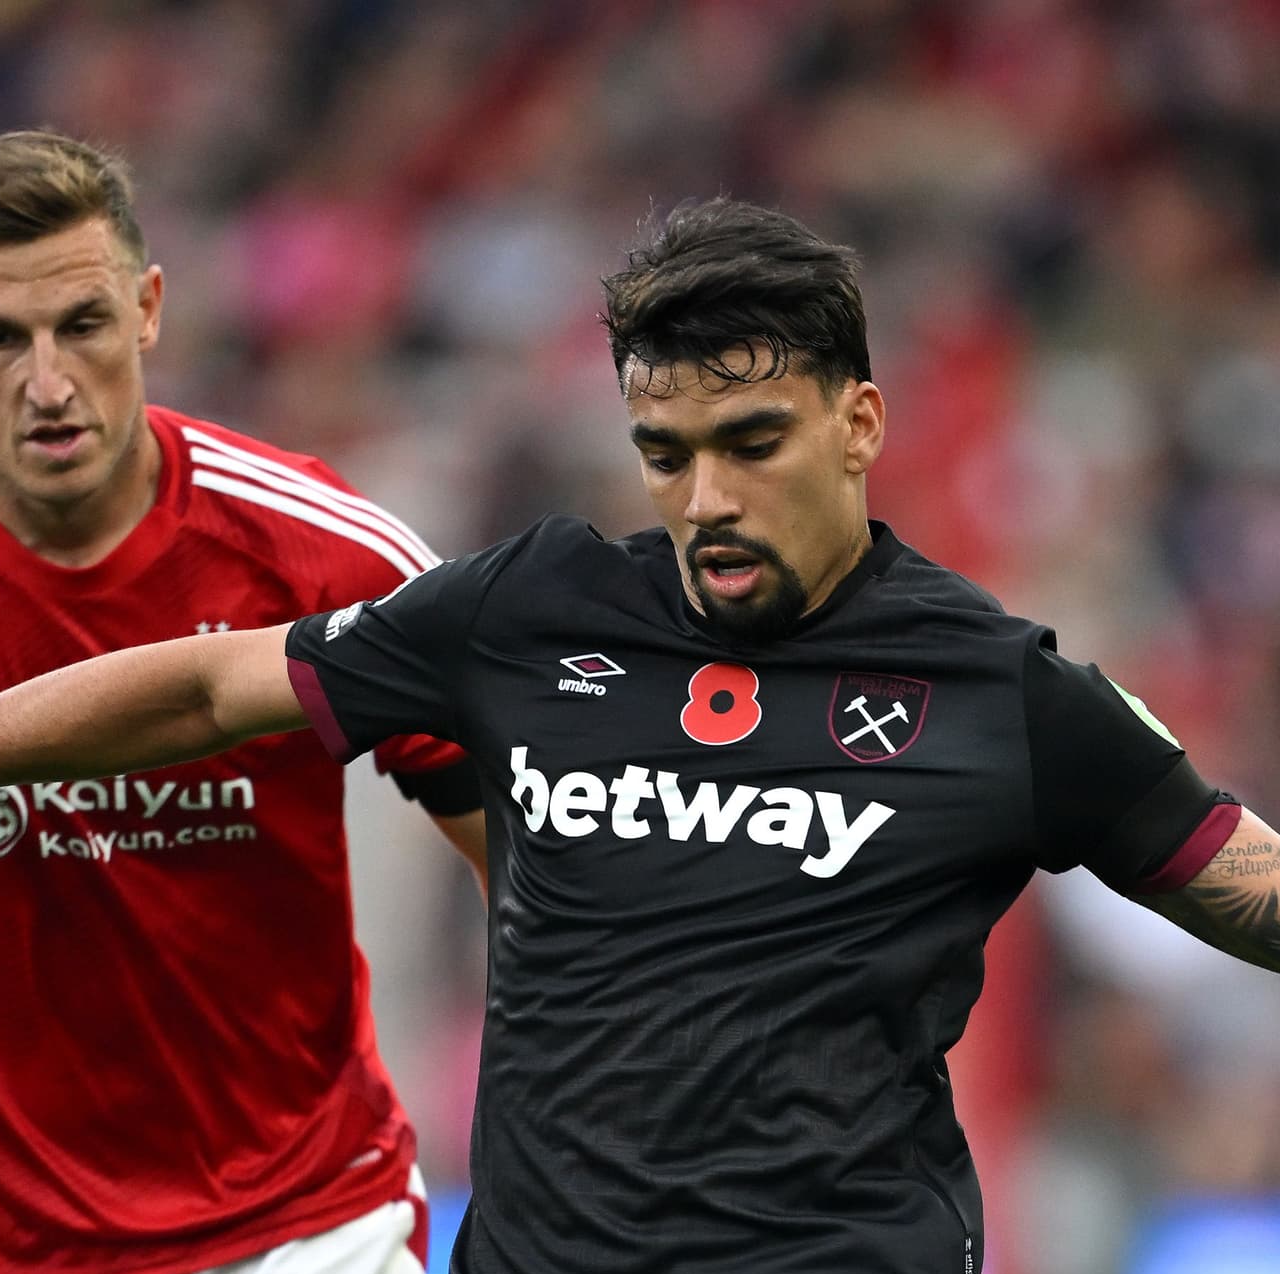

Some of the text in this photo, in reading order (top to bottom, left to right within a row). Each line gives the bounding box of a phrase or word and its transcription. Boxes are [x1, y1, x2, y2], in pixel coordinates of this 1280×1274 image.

[558, 678, 607, 696] umbro
[32, 774, 256, 818] Kaiyun
[510, 746, 897, 878] betway
[38, 822, 256, 863] Kaiyun.com
